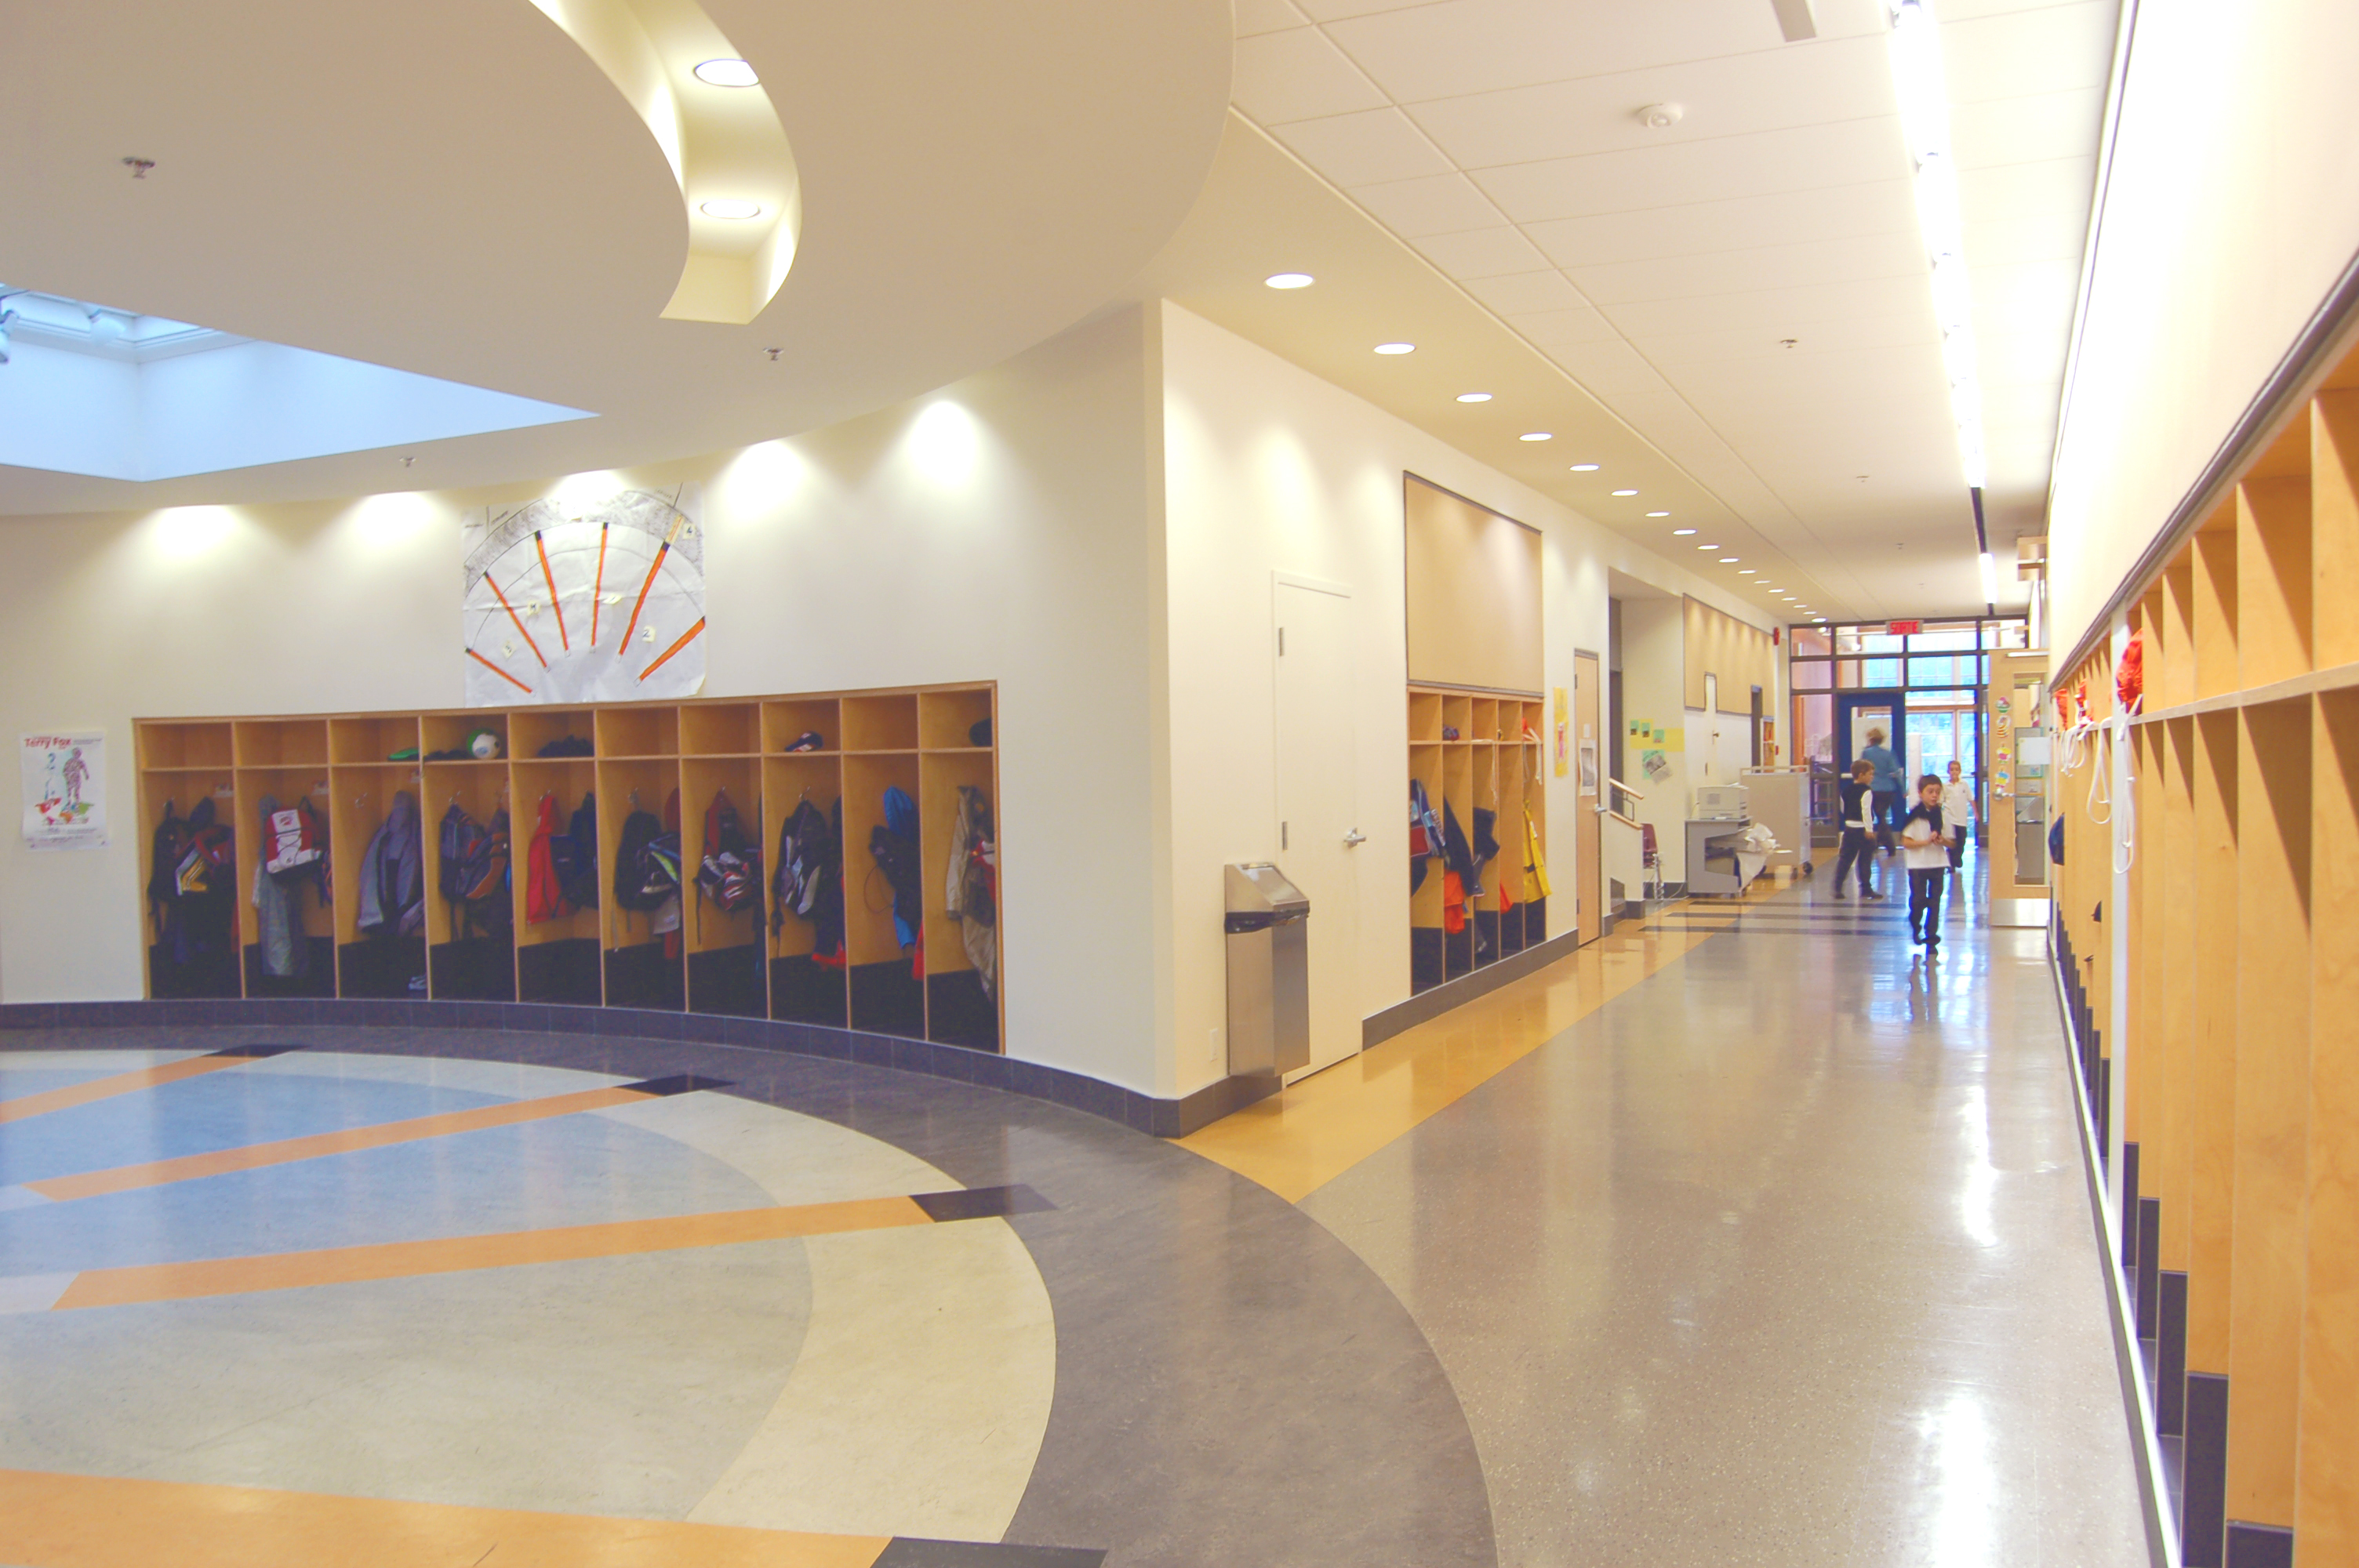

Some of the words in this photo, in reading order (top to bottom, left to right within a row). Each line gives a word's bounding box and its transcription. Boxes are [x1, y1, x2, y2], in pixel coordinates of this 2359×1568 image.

[642, 629, 650, 637] 2
[1890, 620, 1919, 634] SORTIE
[24, 737, 52, 750] Terry
[53, 737, 71, 746] Fox
